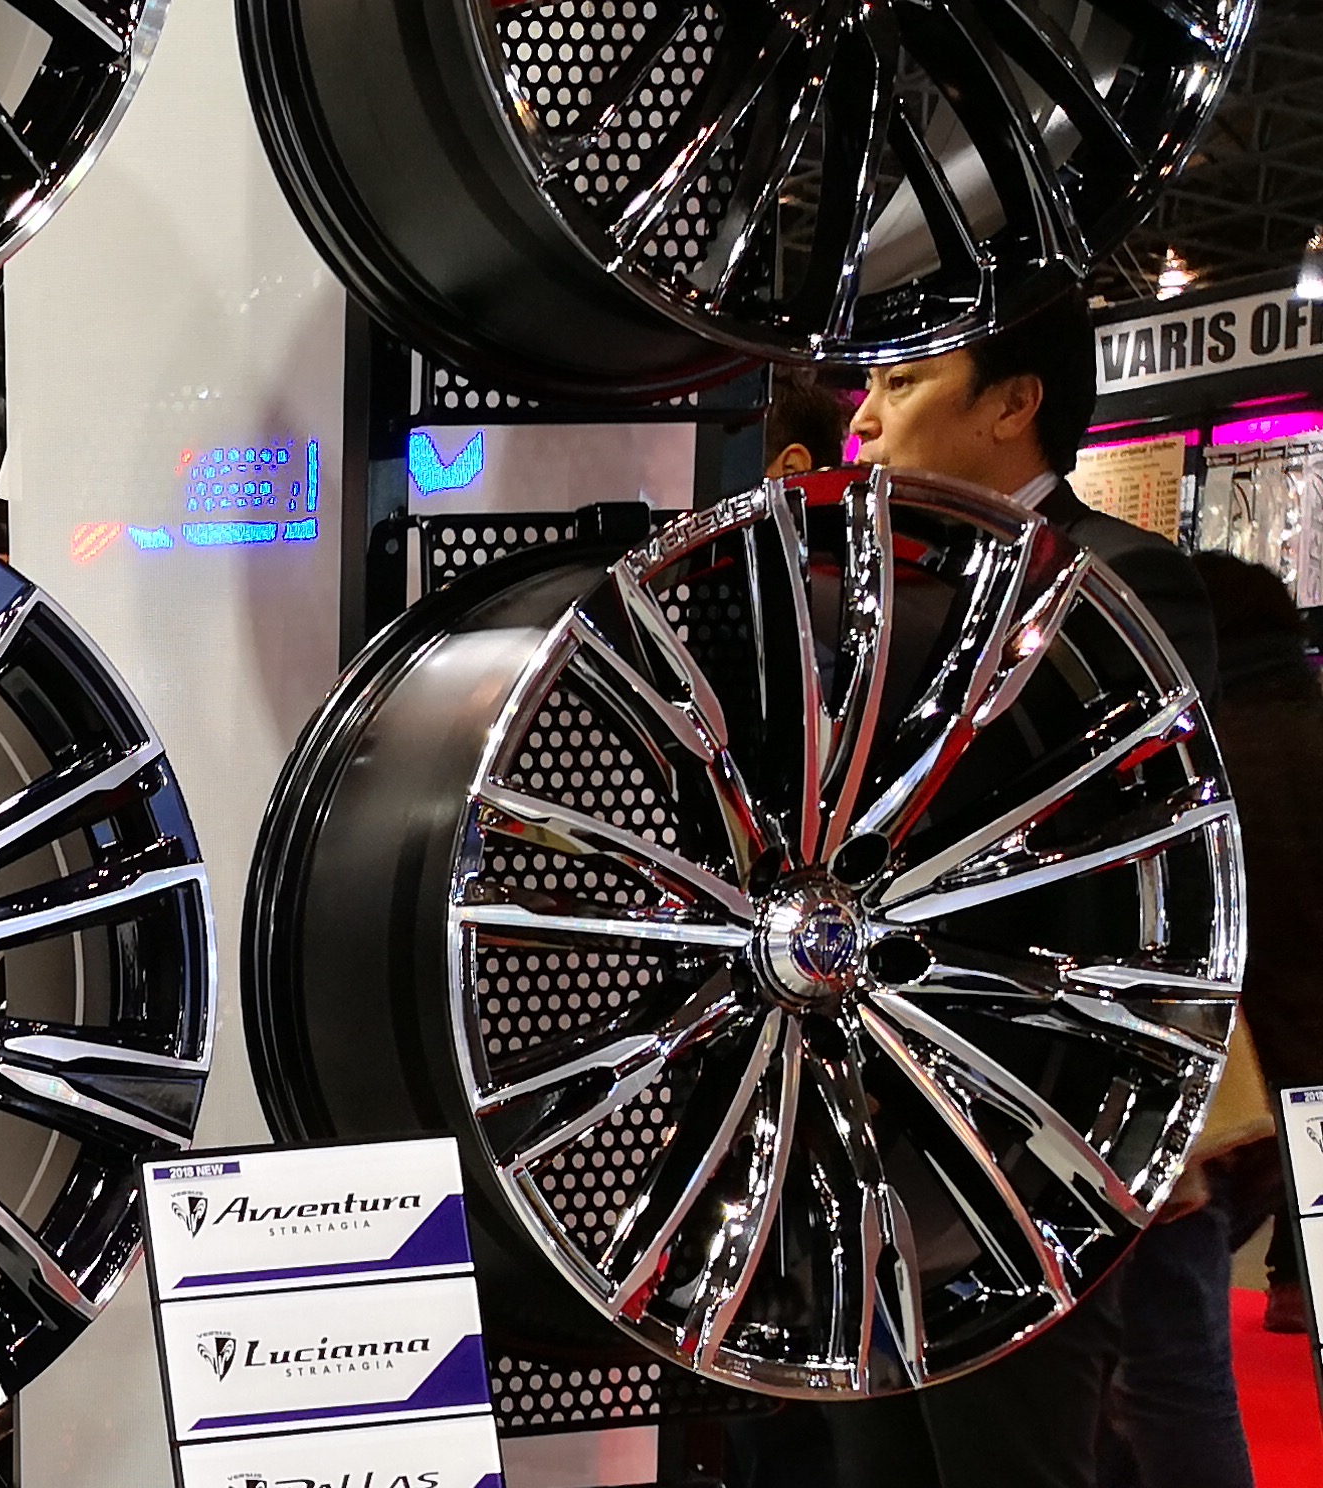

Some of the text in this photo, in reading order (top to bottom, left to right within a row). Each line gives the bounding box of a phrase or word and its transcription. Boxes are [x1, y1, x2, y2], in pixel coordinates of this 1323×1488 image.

[1100, 312, 1235, 382] VARIS
[170, 1163, 224, 1178] 2018 NEW
[213, 1194, 421, 1225] Avventura
[269, 1220, 370, 1235] STRATAGIA
[244, 1338, 429, 1366] Lucianna
[285, 1360, 394, 1378] STRATAGIA
